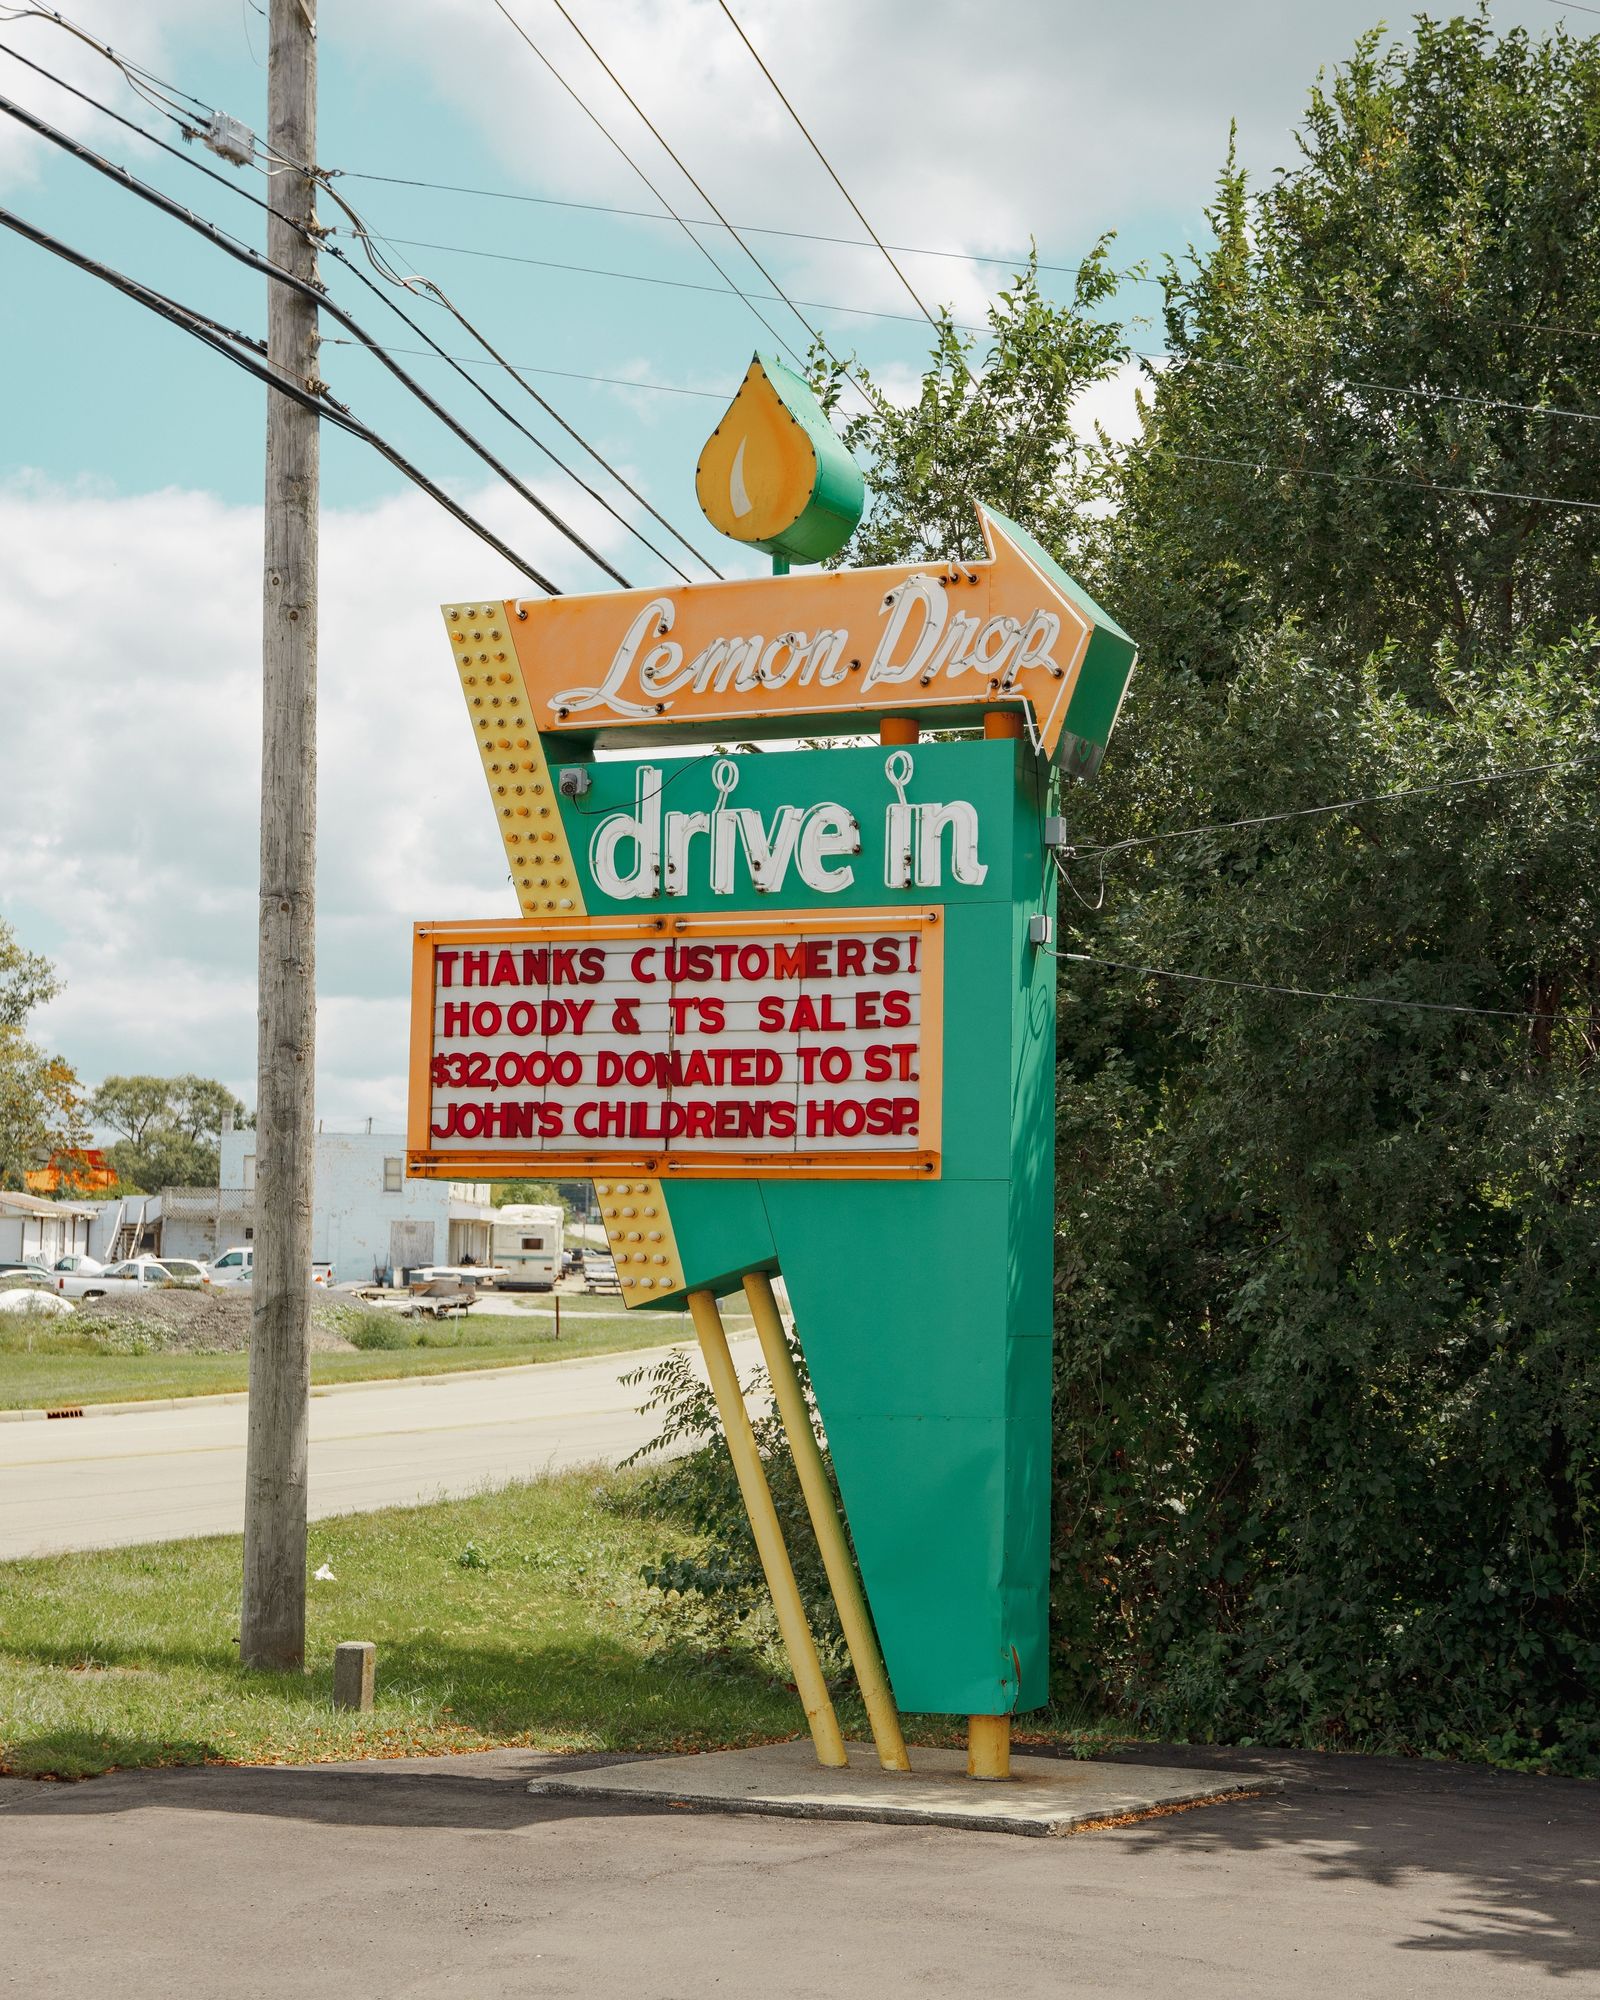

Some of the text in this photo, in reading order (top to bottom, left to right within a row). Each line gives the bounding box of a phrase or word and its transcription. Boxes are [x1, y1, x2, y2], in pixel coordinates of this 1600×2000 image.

[547, 572, 1062, 718] Lemon Drop
[588, 750, 989, 900] drive in
[435, 935, 918, 988] THANKS CUSTOMERS!
[443, 990, 912, 1037] HOODY & T'S SALES
[430, 1043, 920, 1092] $32,000 DONATED TO ST.
[430, 1097, 920, 1139] JOHN'S CHILDREN'S HOSP.
